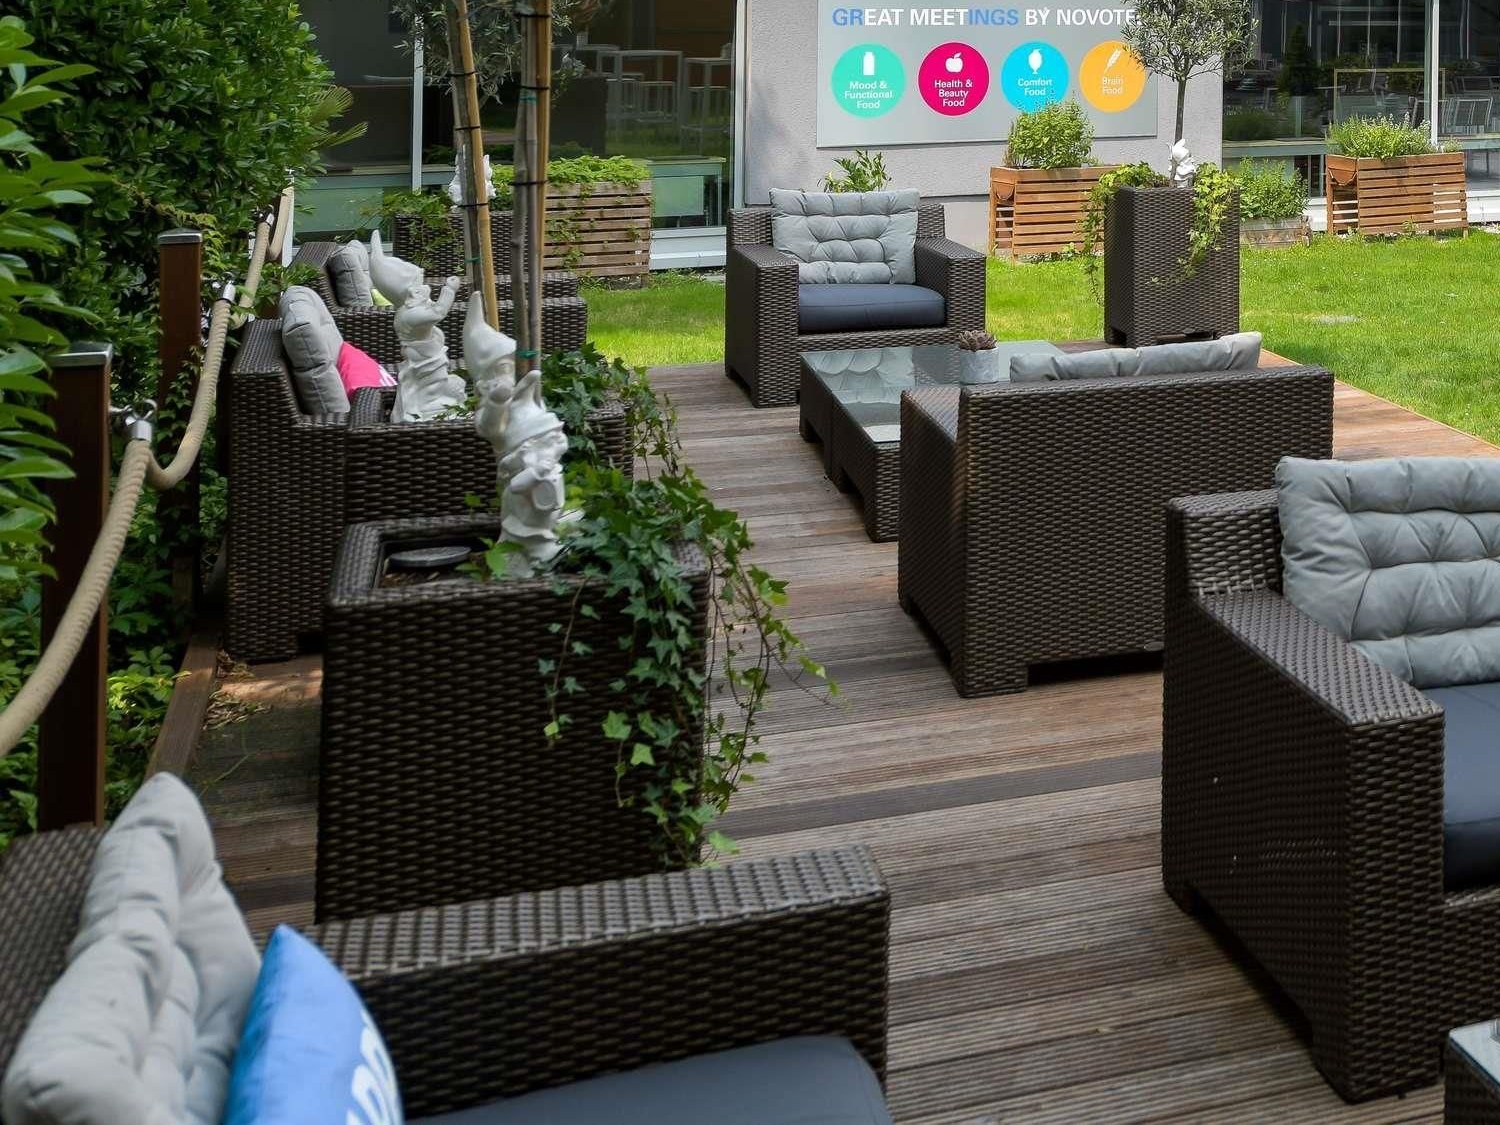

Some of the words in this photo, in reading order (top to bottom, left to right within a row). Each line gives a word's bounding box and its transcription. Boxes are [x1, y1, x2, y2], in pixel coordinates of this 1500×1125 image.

[832, 7, 904, 26] GREAT
[909, 8, 1019, 26] MEETINGS
[1025, 8, 1050, 26] BY
[849, 80, 877, 90] Mood
[879, 80, 888, 89] &
[934, 78, 963, 89] Health
[965, 78, 973, 88] &
[1017, 77, 1053, 87] Comfort
[1102, 76, 1124, 85] Brain
[844, 90, 893, 100] Functional
[938, 88, 969, 98] Beauty
[1024, 87, 1046, 96] Food
[1102, 86, 1123, 95] Food
[856, 99, 881, 109] Food
[942, 98, 965, 107] Food
